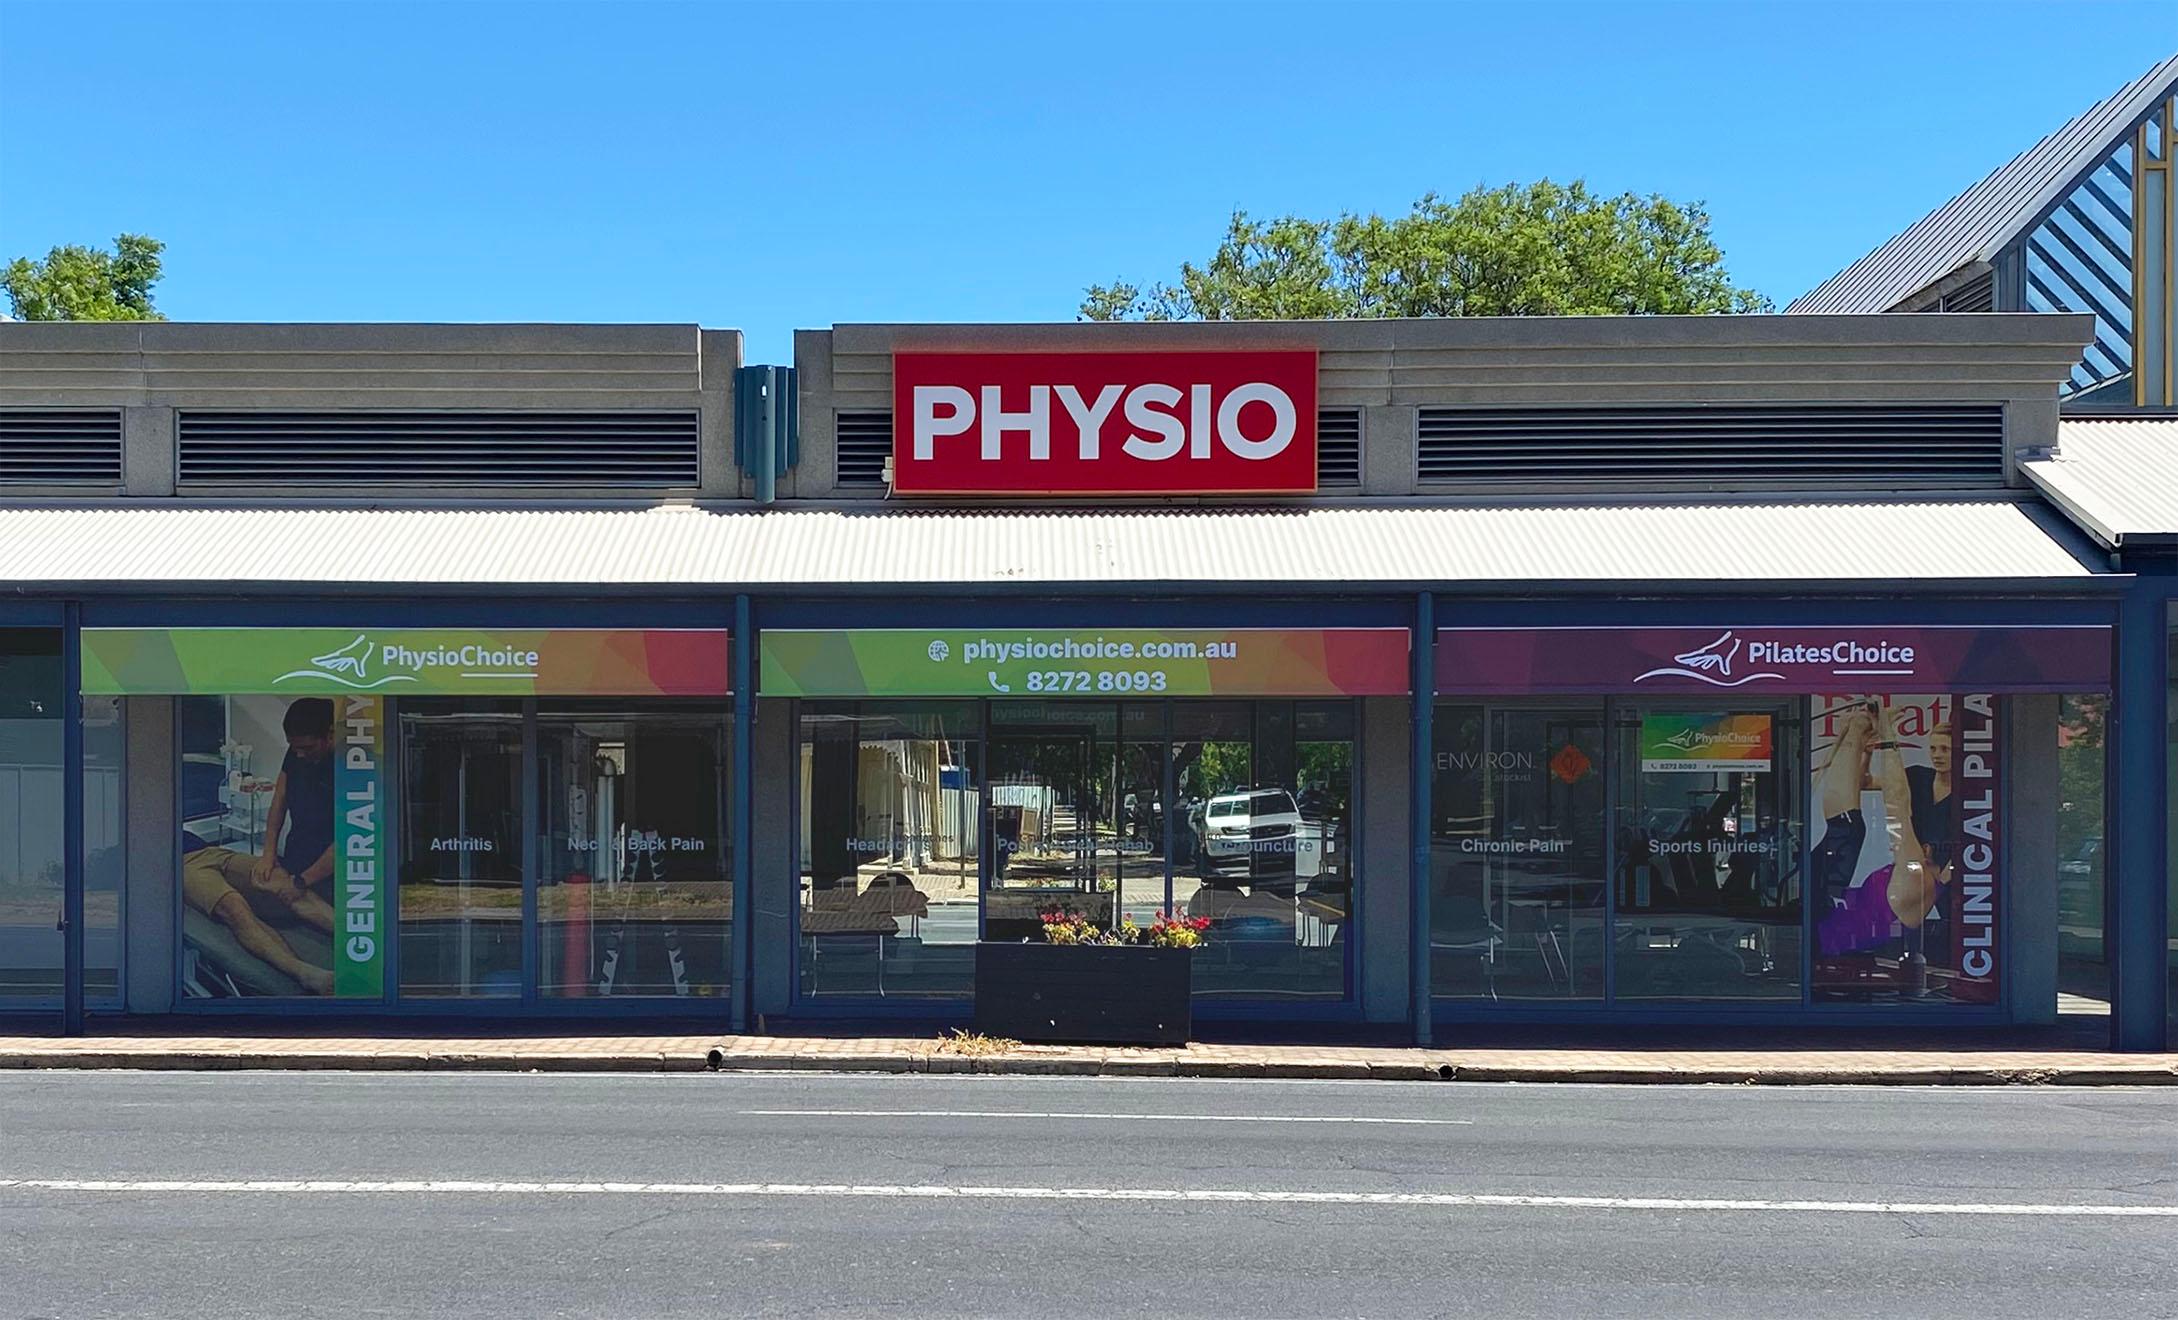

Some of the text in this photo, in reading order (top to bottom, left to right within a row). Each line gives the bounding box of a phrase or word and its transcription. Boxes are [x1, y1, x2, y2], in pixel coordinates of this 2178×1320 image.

[913, 382, 1297, 460] PHYSIO
[383, 645, 539, 671] PhysioChoice
[963, 637, 1237, 663] physiochoice.com.au
[1749, 641, 1915, 663] PilatesChoice
[1026, 671, 1168, 691] 8272 8093
[346, 695, 375, 962] GENERAL PHY
[1962, 694, 1993, 977] CLINICAL PILA
[430, 838, 493, 850] Arthritis
[567, 838, 607, 850] Nec
[629, 838, 666, 850] Back
[671, 838, 705, 850] Pain
[1461, 839, 1564, 852] Chronic Pain
[1649, 840, 1702, 856] Sports
